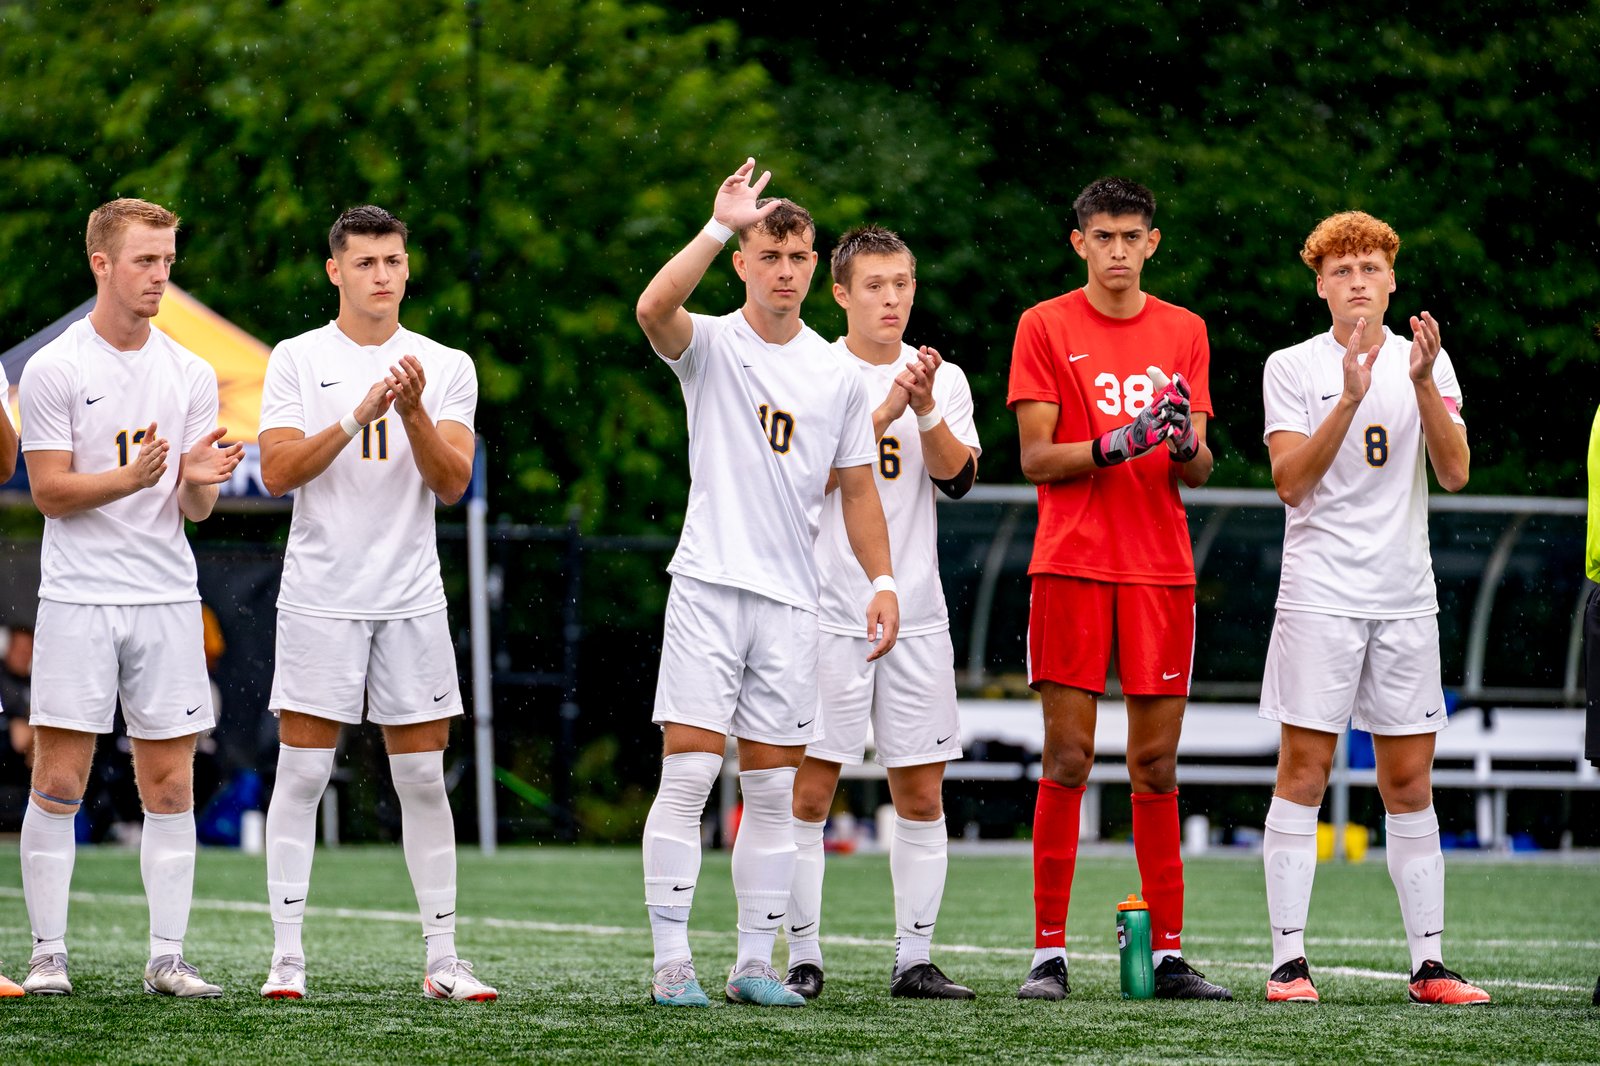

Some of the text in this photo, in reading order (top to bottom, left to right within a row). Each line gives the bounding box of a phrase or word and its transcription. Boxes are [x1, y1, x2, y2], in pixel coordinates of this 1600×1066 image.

[1094, 372, 1154, 418] 38
[361, 418, 388, 460] 11
[878, 436, 902, 480] 6
[1363, 424, 1389, 468] 8
